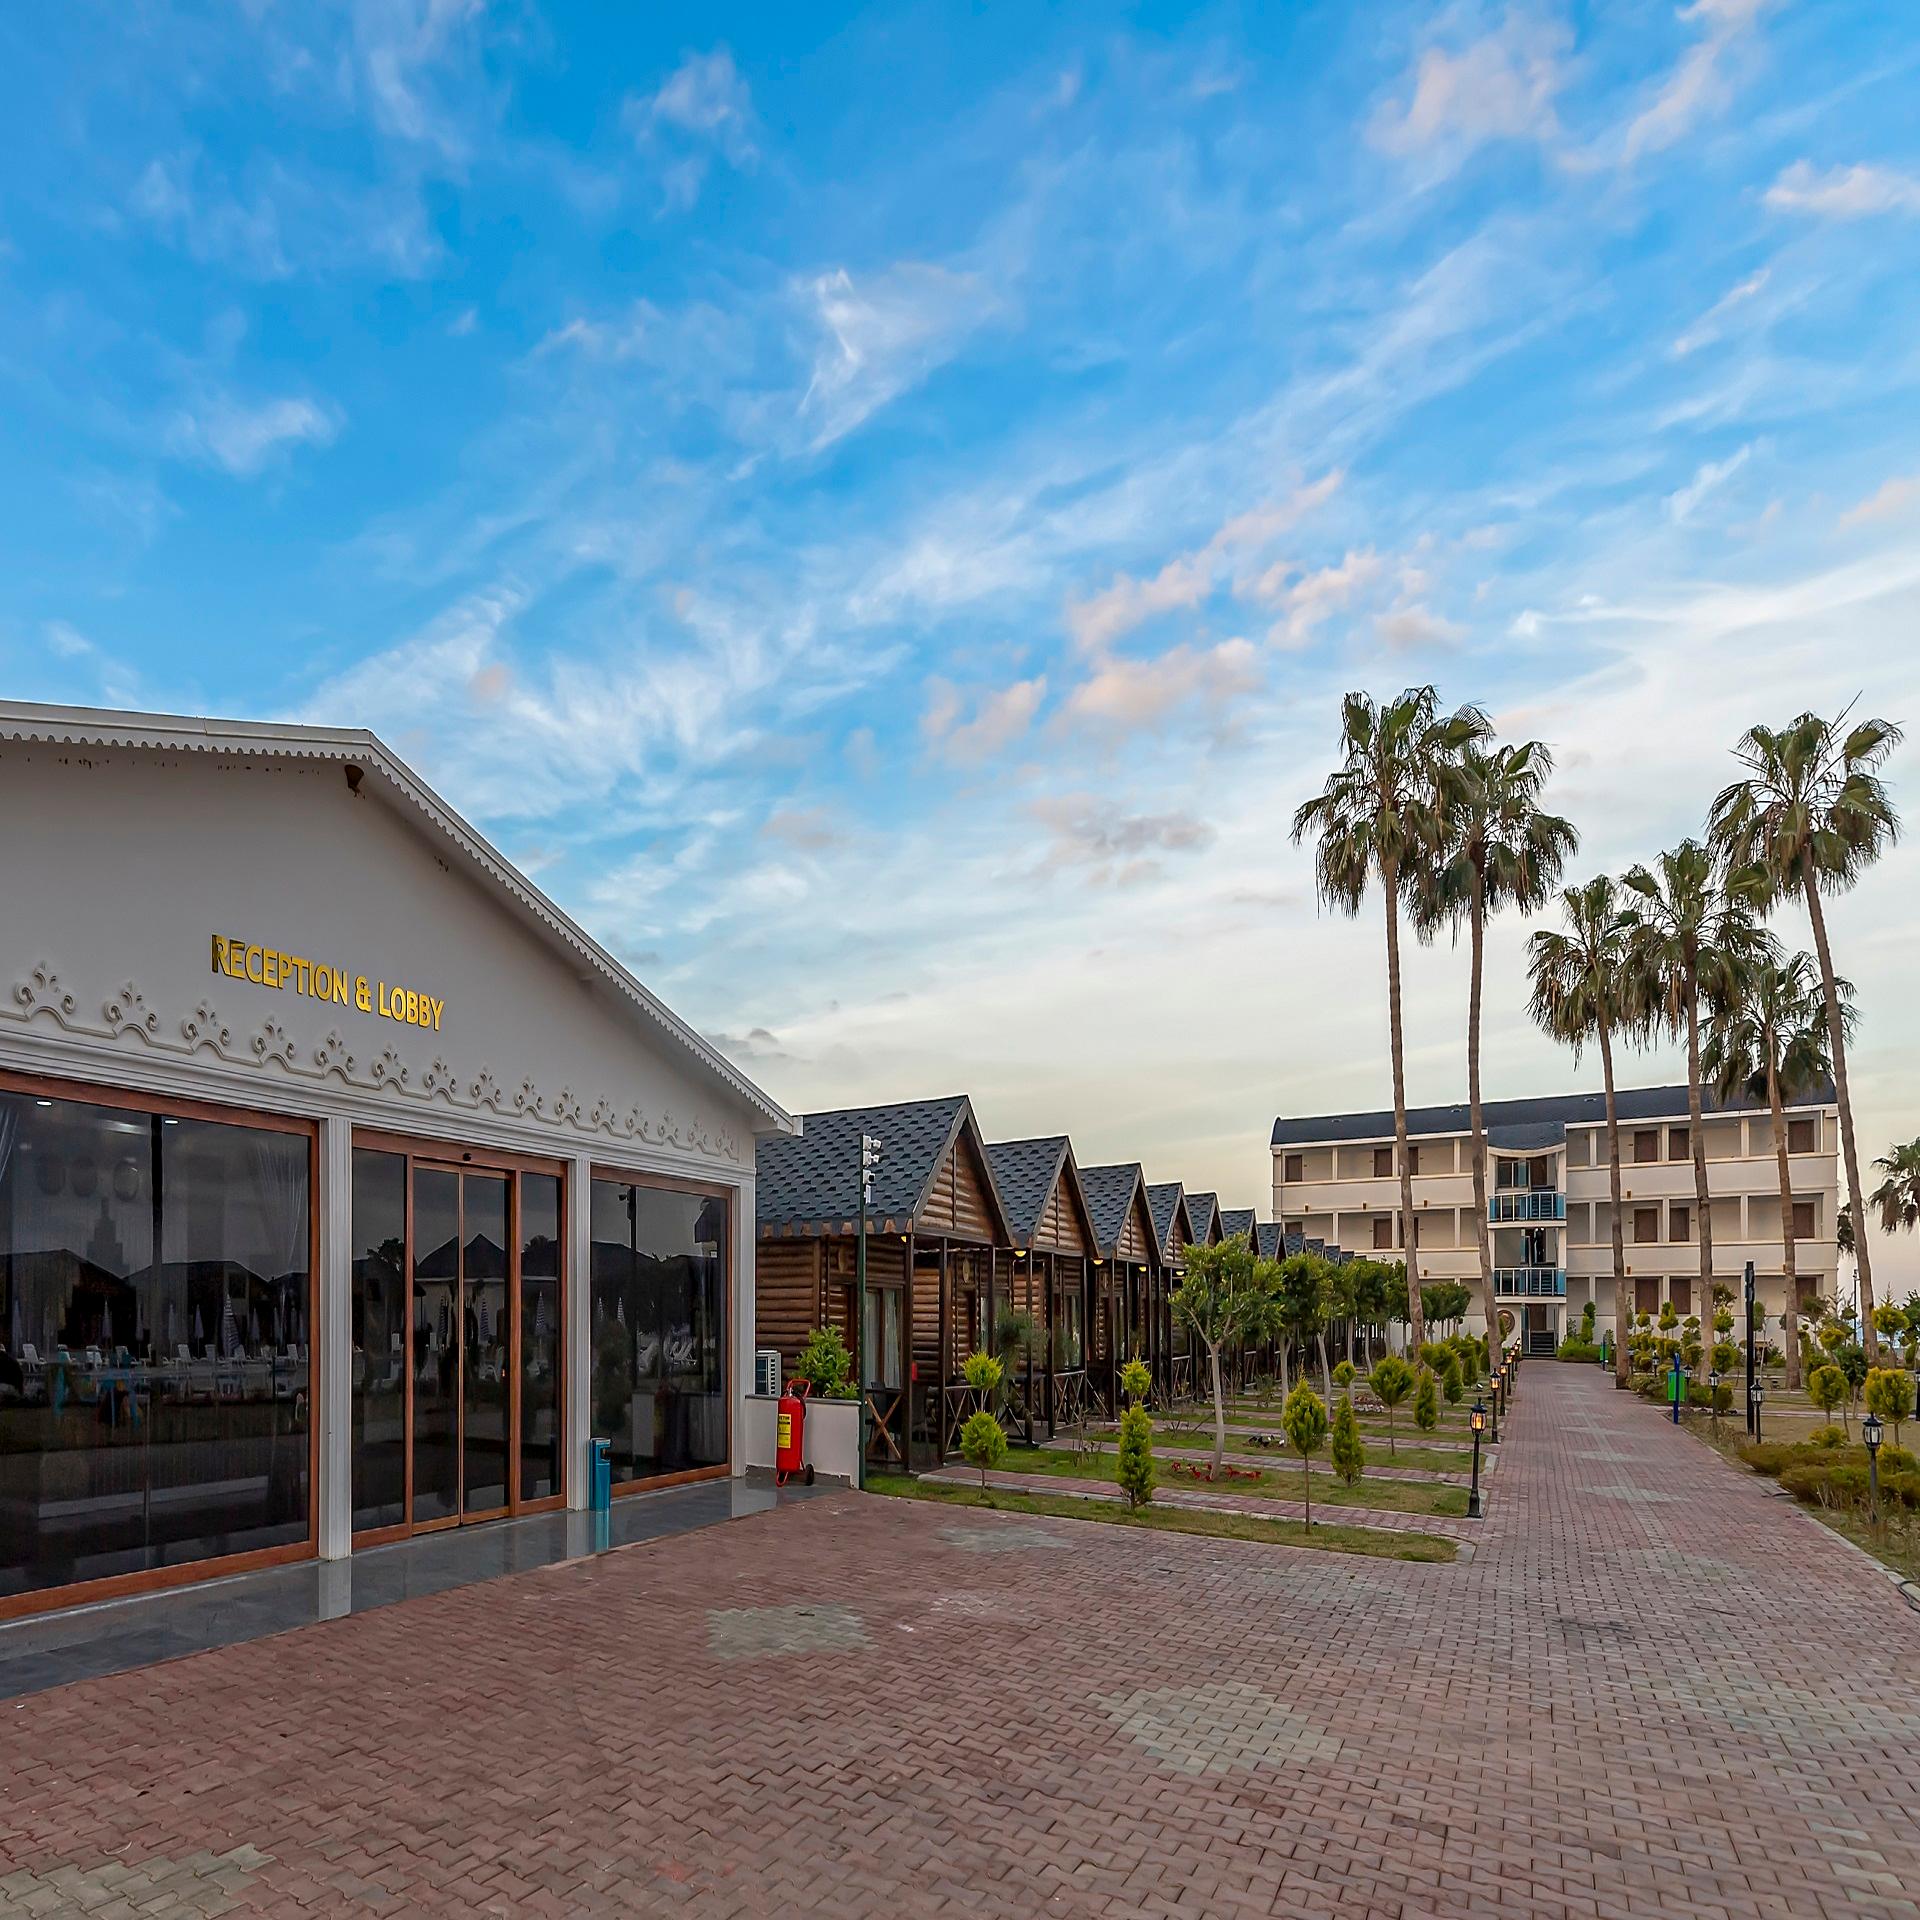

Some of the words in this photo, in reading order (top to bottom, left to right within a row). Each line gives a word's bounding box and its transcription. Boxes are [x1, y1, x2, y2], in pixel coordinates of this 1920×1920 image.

[211, 933, 348, 1006] RECEPTION
[355, 975, 372, 1012] &
[378, 982, 444, 1031] LOBBY
